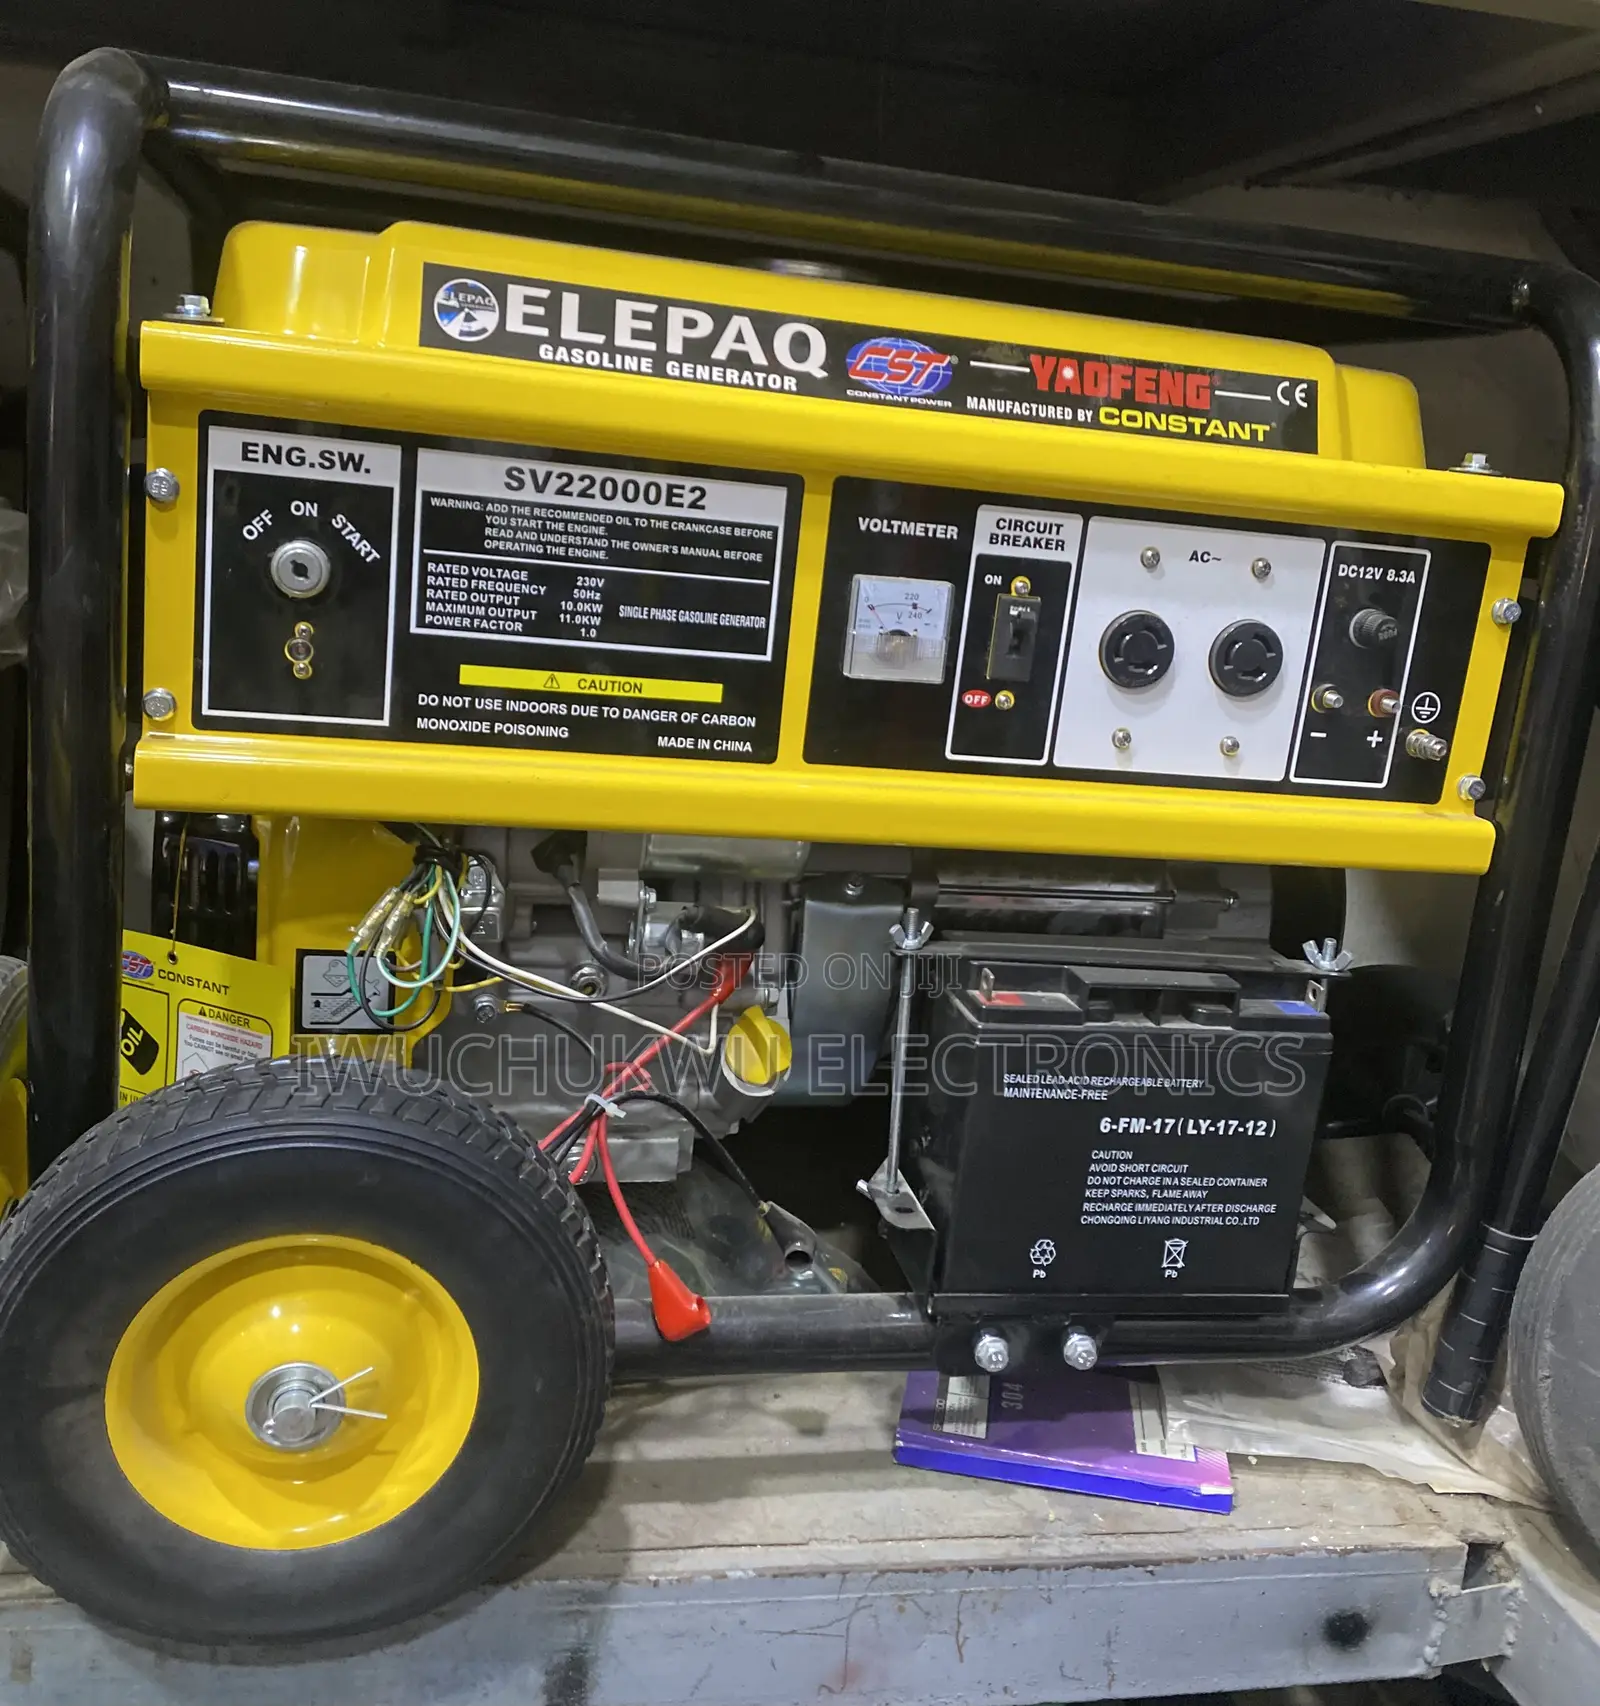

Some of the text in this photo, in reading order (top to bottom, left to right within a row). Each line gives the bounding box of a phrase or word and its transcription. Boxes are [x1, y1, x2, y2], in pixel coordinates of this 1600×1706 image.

[505, 284, 829, 379] ELEPAQ
[539, 344, 798, 392] GASOLINE GENERATOR
[846, 389, 952, 408] CONSTANT POWER
[966, 395, 1272, 442] MANUFACTURED BY CONSTANT
[242, 441, 371, 474] ENG.SW.
[504, 466, 707, 510] SV22000E2
[290, 500, 318, 517] ON
[242, 509, 274, 541] OFF
[431, 497, 773, 540] WARNING: ADD THE RECOMMENDED OIL TO THE CRANKCASE BEFORE
[485, 515, 608, 536] YOU START THE ENGINE.
[858, 516, 959, 540] VOLTMETER
[996, 517, 1064, 536] CIRCUIT
[332, 513, 381, 563] START
[485, 527, 763, 563] READ AND UNDERSTAND THE OWNER'S MANUAL BEFORE
[989, 533, 1066, 551] BREAKER
[484, 539, 608, 560] OPERATING THE ENGINE.
[428, 562, 528, 581] RATED VOLTAGE
[984, 574, 1002, 585] ON
[1338, 563, 1416, 583] DC12V 8.3A
[427, 575, 547, 596] RATED FREQUENCY
[577, 576, 605, 588] 230V
[426, 588, 520, 606] RATED OUTPUT
[573, 589, 601, 600] 50Hz
[905, 592, 919, 600] 220
[426, 601, 538, 621] MAXIMUM OUTPUT
[560, 600, 603, 613] 10.0KW
[425, 614, 522, 632] POWER FACTOR
[559, 613, 601, 626] 11.0KW
[619, 605, 766, 629] SINGLE PHASE GASOLINE GENERATOR
[581, 627, 597, 638] 1.0
[578, 678, 643, 694] CAUTION
[965, 694, 989, 705] OFF
[418, 693, 756, 728] DO NOT USE INDOORS DUE TO DANGER OF CARBON
[417, 717, 569, 738] MONOXIDE POISONING
[657, 736, 752, 753] MADE IN CHINA
[158, 969, 230, 995] CONSTANT
[209, 1009, 250, 1028] DANGER
[121, 1027, 143, 1056] OIL
[1003, 1074, 1205, 1089] SEALED LEAD-ACID RECHARGEABLE BATTERY
[1004, 1088, 1108, 1101] MAINTENANCE-FREE
[1091, 1150, 1133, 1160] CAUTION
[1089, 1164, 1188, 1174] AVOID SHORT CIRCUIT
[1087, 1176, 1268, 1187] DO NOT CHARGE IN A SEALED CONTAINER
[1085, 1189, 1208, 1200] KEEP SPARKS, FLAME AWAY
[1083, 1203, 1277, 1214] RECHARGE IMMEDIATELY AFTER DISCHARGE
[1080, 1216, 1137, 1225] CHONGQING
[1138, 1216, 1170, 1225] LIYANG
[1171, 1216, 1223, 1226] INDUSTRIAL
[1033, 1270, 1046, 1279] Pb
[1164, 1270, 1178, 1279] Pb
[1001, 1382, 1024, 1410] 304
